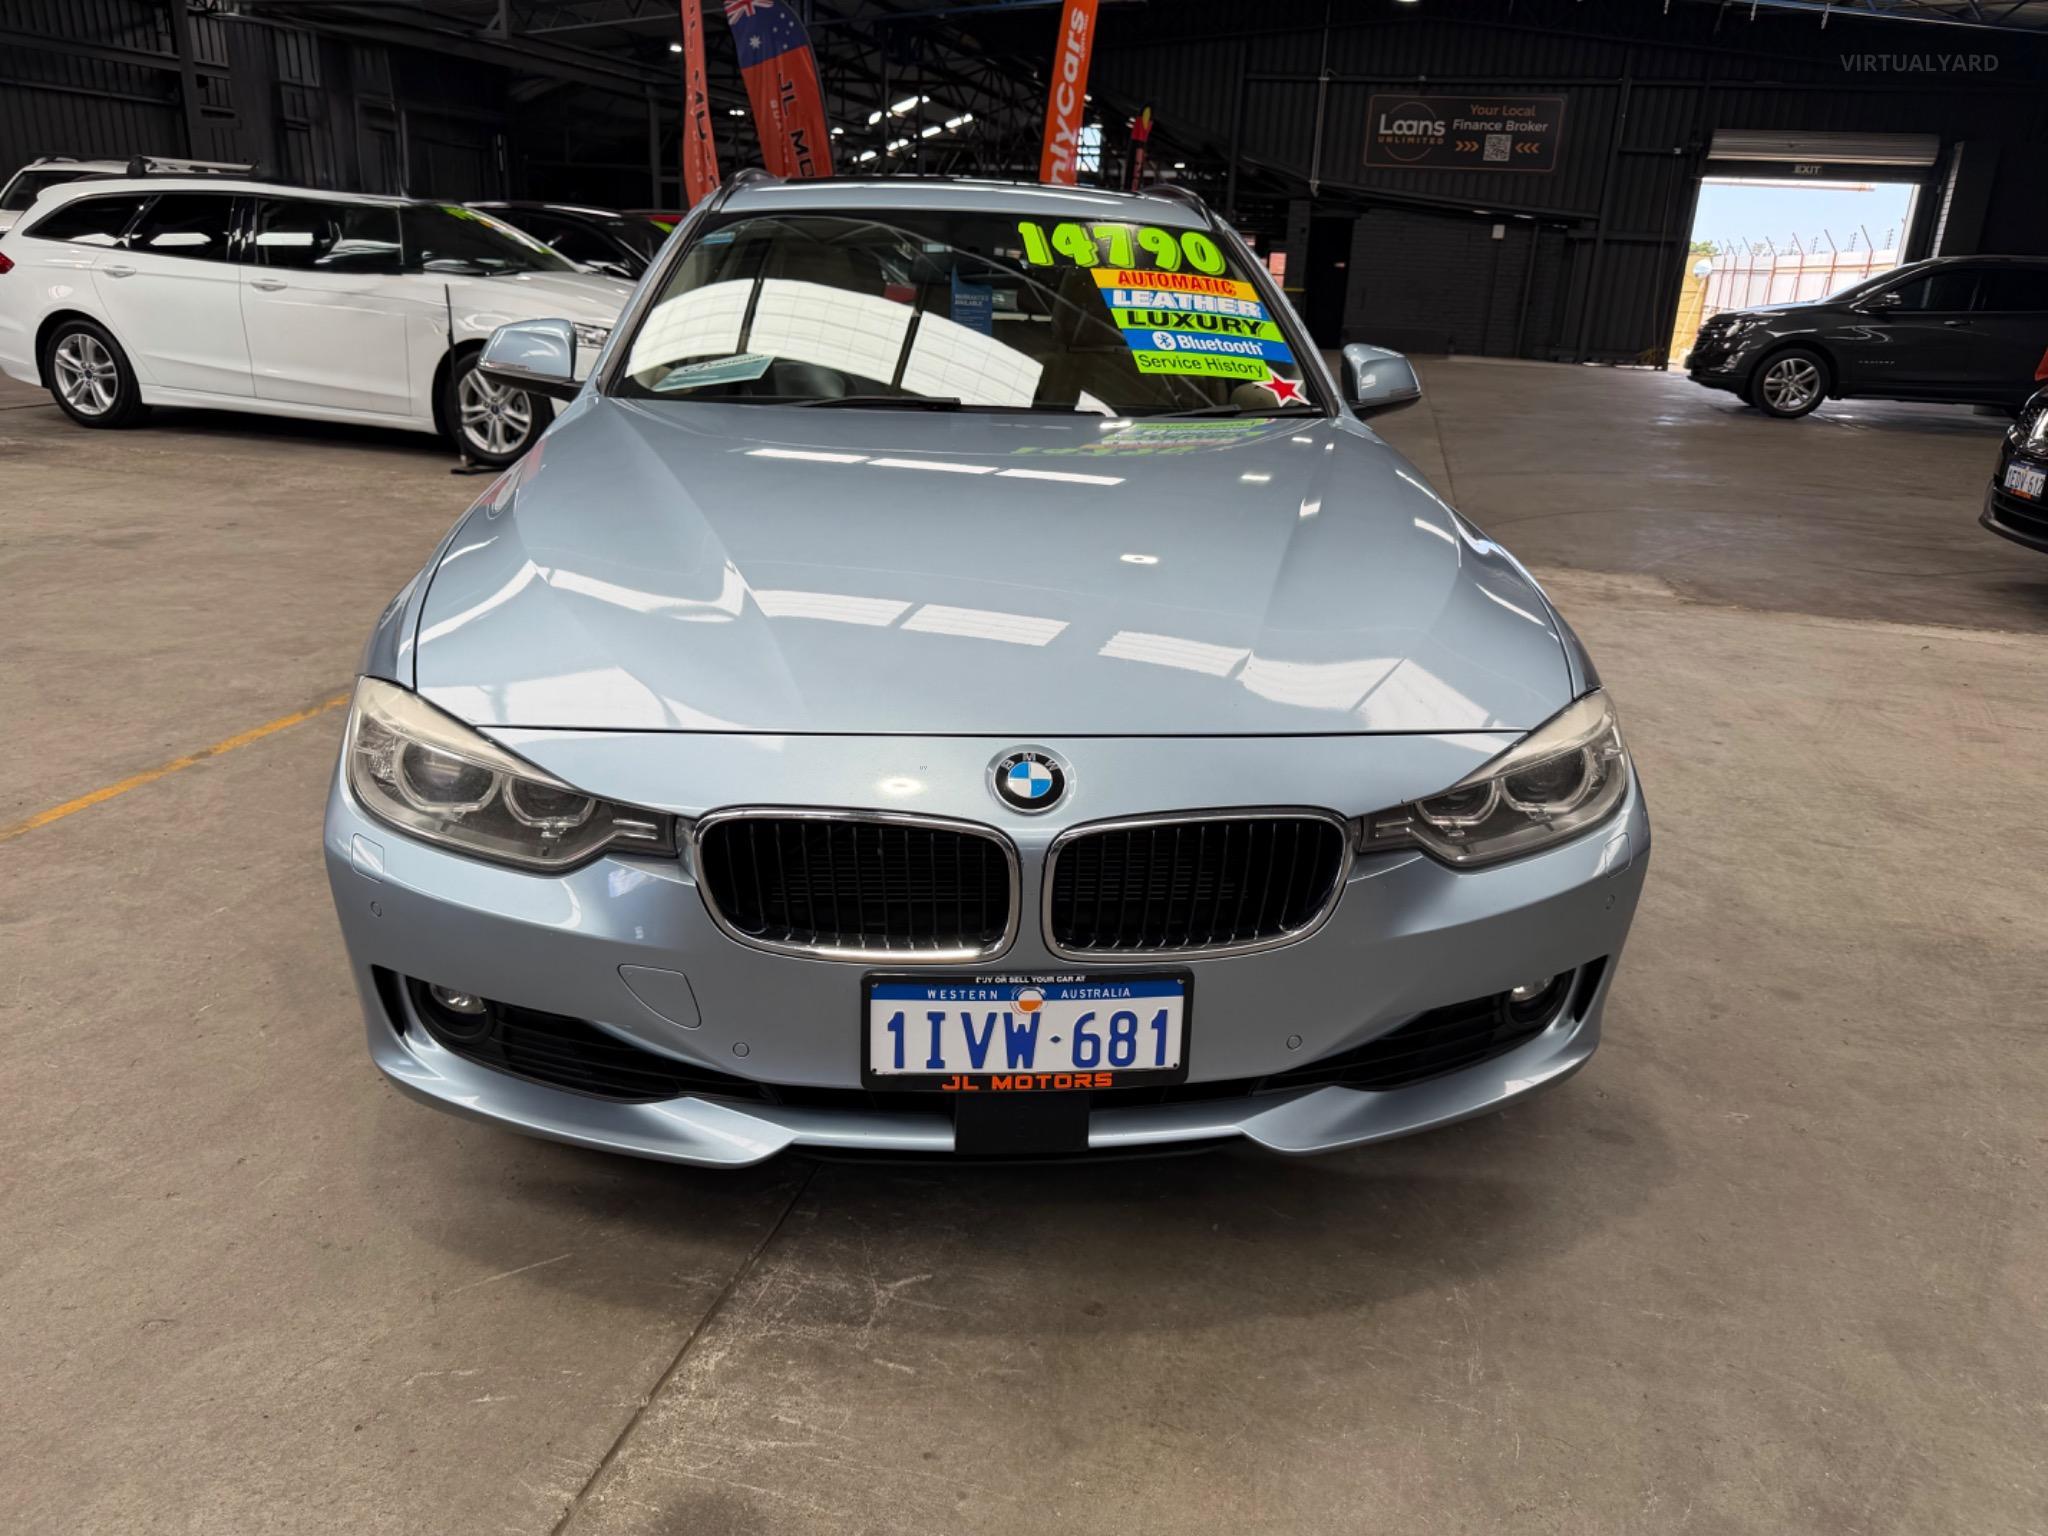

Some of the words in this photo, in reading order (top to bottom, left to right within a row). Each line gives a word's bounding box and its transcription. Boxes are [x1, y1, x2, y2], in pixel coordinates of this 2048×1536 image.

[778, 73, 796, 116] JL
[1470, 104, 1500, 116] Your
[1502, 105, 1536, 117] Local
[1378, 113, 1446, 136] Loans
[1452, 119, 1503, 131] Finance
[1505, 120, 1548, 133] Broker
[1377, 135, 1445, 145] UNLIMITED
[1793, 164, 1822, 175] EXIT
[1018, 221, 1227, 276] 14790
[1117, 270, 1237, 297] AUTOMATIC
[1112, 289, 1262, 318] LEATHER
[1127, 310, 1265, 336] LUXURY
[1177, 334, 1263, 356] Bluetooth
[1138, 354, 1201, 370] Service
[1206, 357, 1263, 378] History
[1001, 752, 1060, 771] BMW
[927, 989, 998, 1001] WESTERN
[1060, 988, 1131, 999] AUSTRALIA
[942, 1074, 979, 1090] JL
[991, 1072, 1113, 1090] MOTORS
